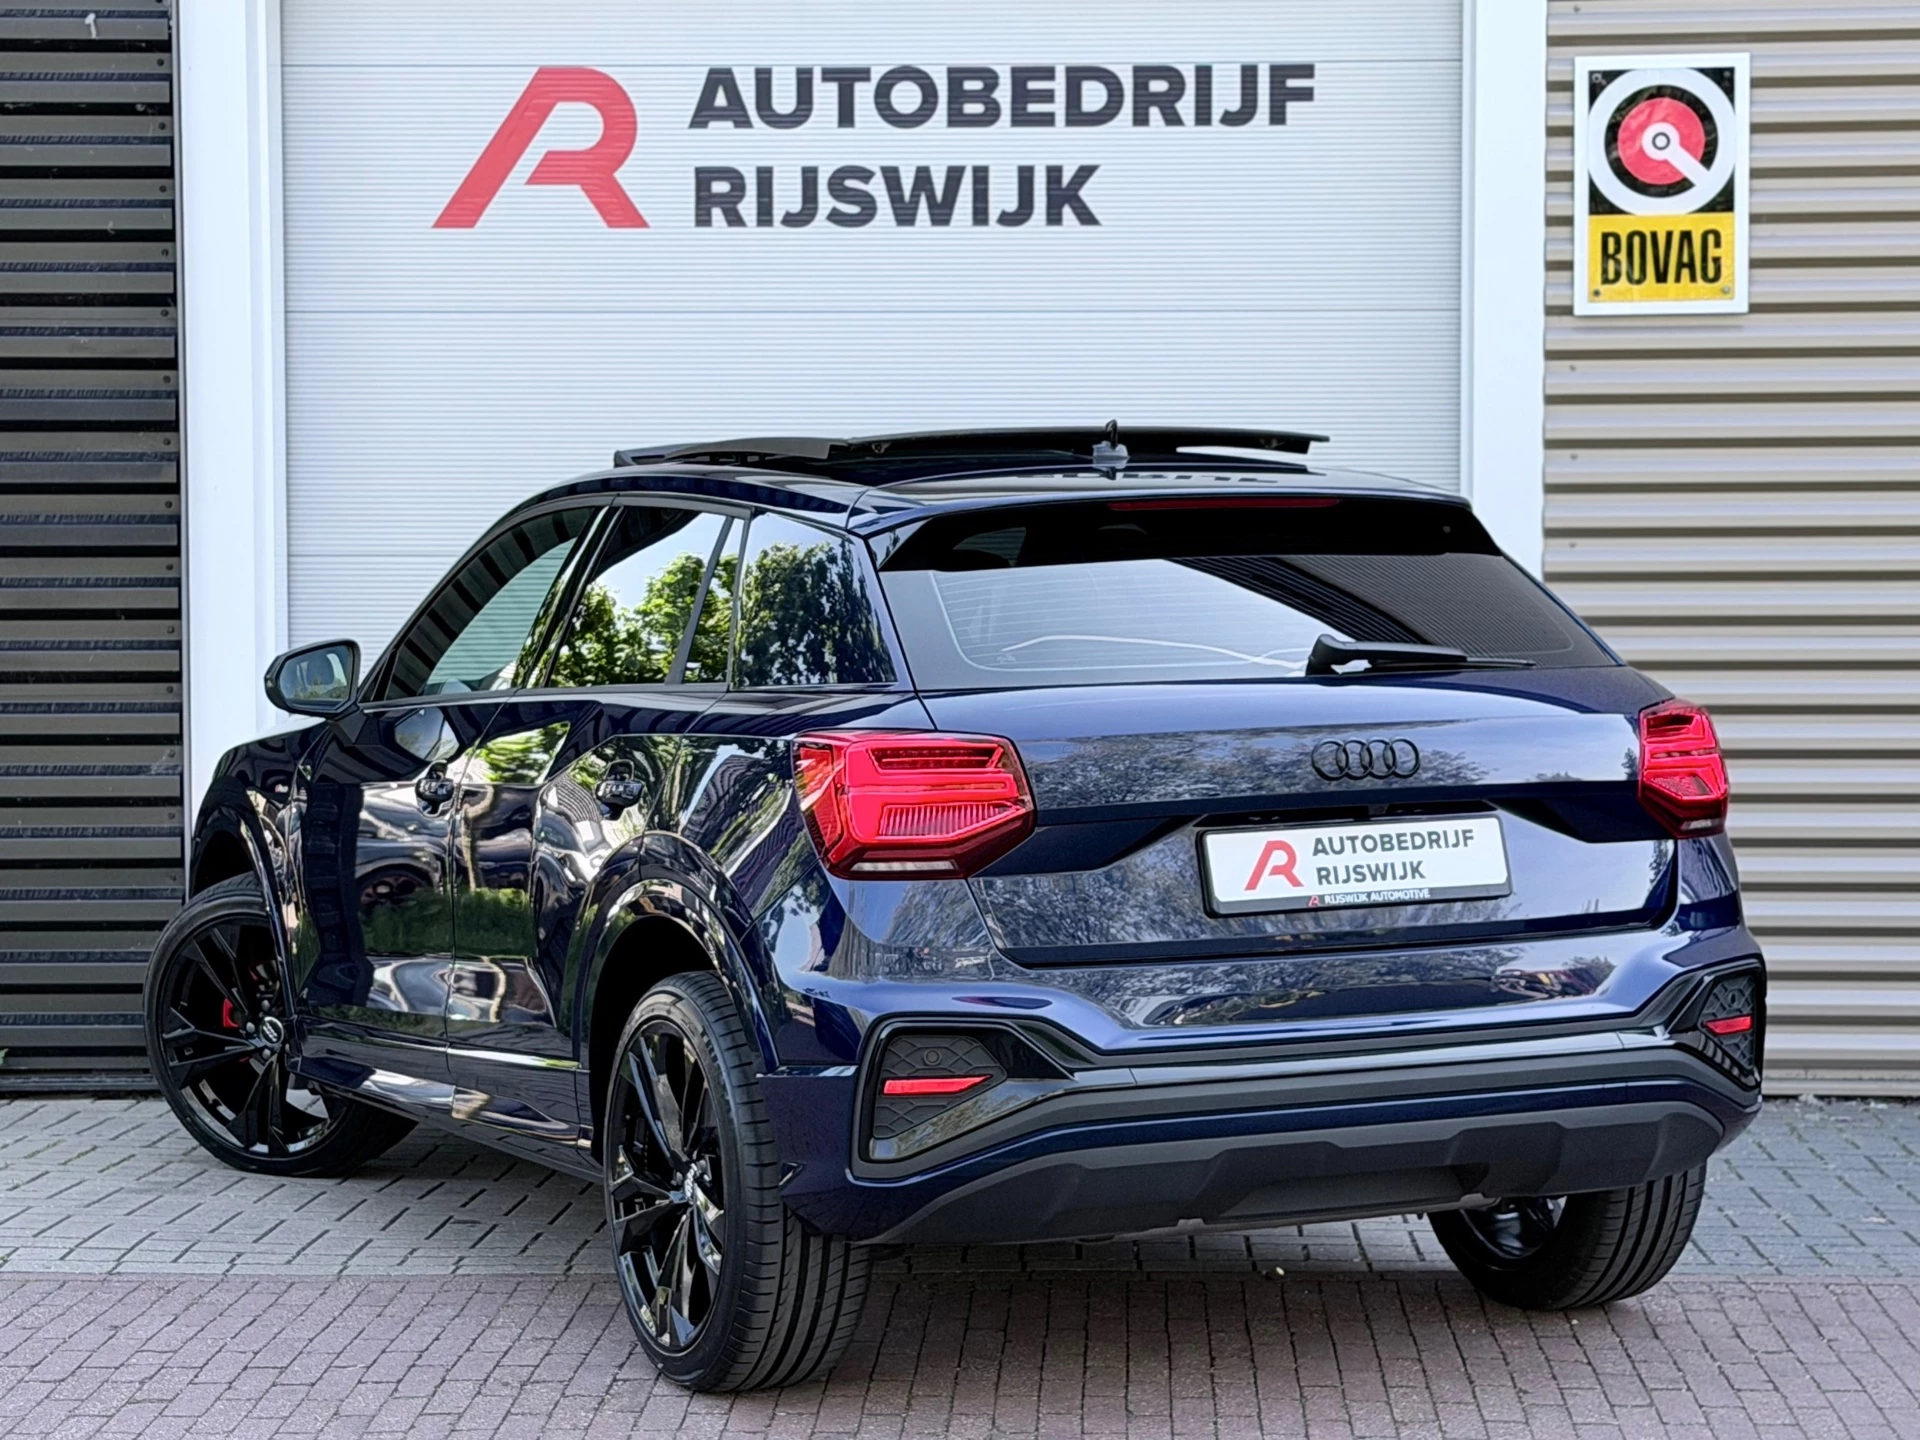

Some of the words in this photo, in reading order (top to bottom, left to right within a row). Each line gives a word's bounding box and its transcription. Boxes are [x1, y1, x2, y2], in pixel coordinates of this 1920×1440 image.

[688, 63, 1315, 129] AUTOBEDRIJF
[694, 164, 1102, 228] RIJSWIJK
[1600, 228, 1722, 286] BOVAG
[1312, 829, 1475, 857] AUTOBEDRIJF
[1316, 860, 1427, 886] RIJSWIJK
[1324, 892, 1369, 905] RIJSWIJK
[1370, 888, 1431, 902] AUTOMOTIVE
